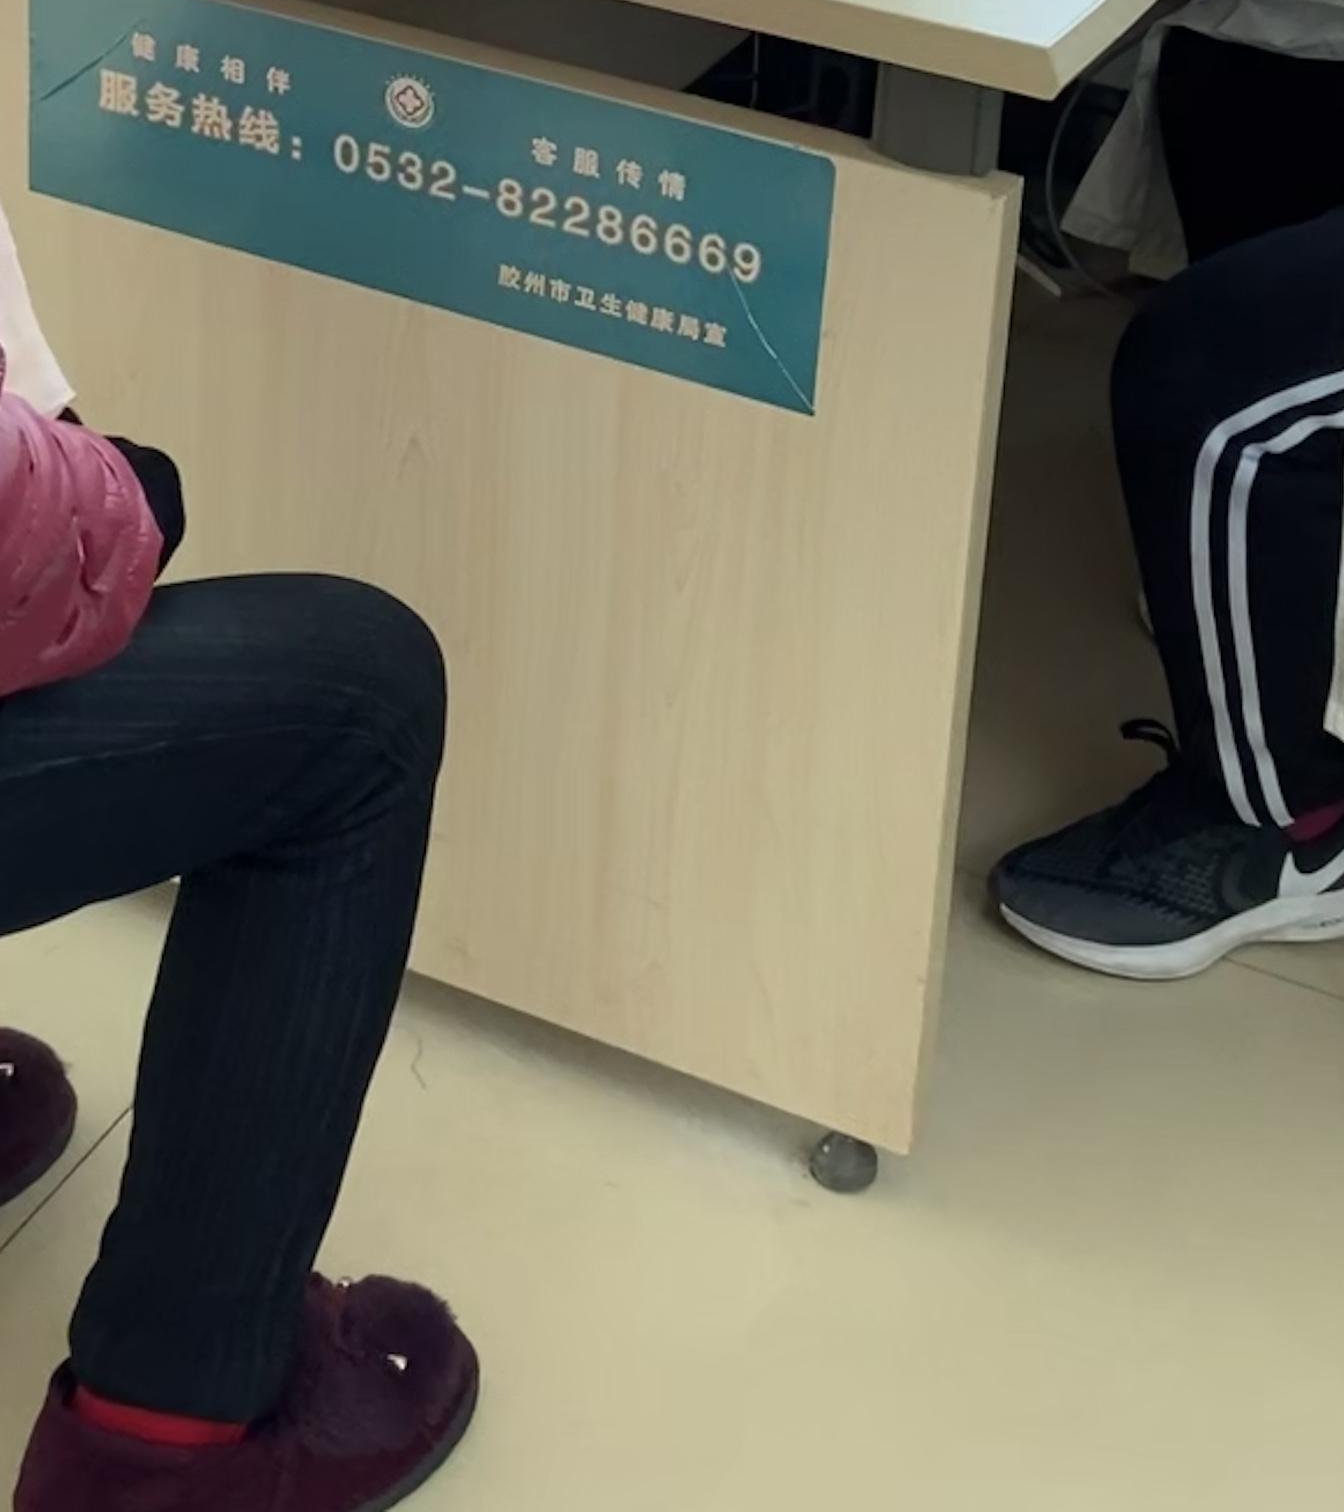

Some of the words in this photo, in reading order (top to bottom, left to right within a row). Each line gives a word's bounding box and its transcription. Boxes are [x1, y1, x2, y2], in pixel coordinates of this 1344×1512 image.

[130, 31, 292, 96] 健康相伴
[530, 135, 688, 202] 客服传情
[498, 263, 728, 349] 胶州市卫生健康局宣
